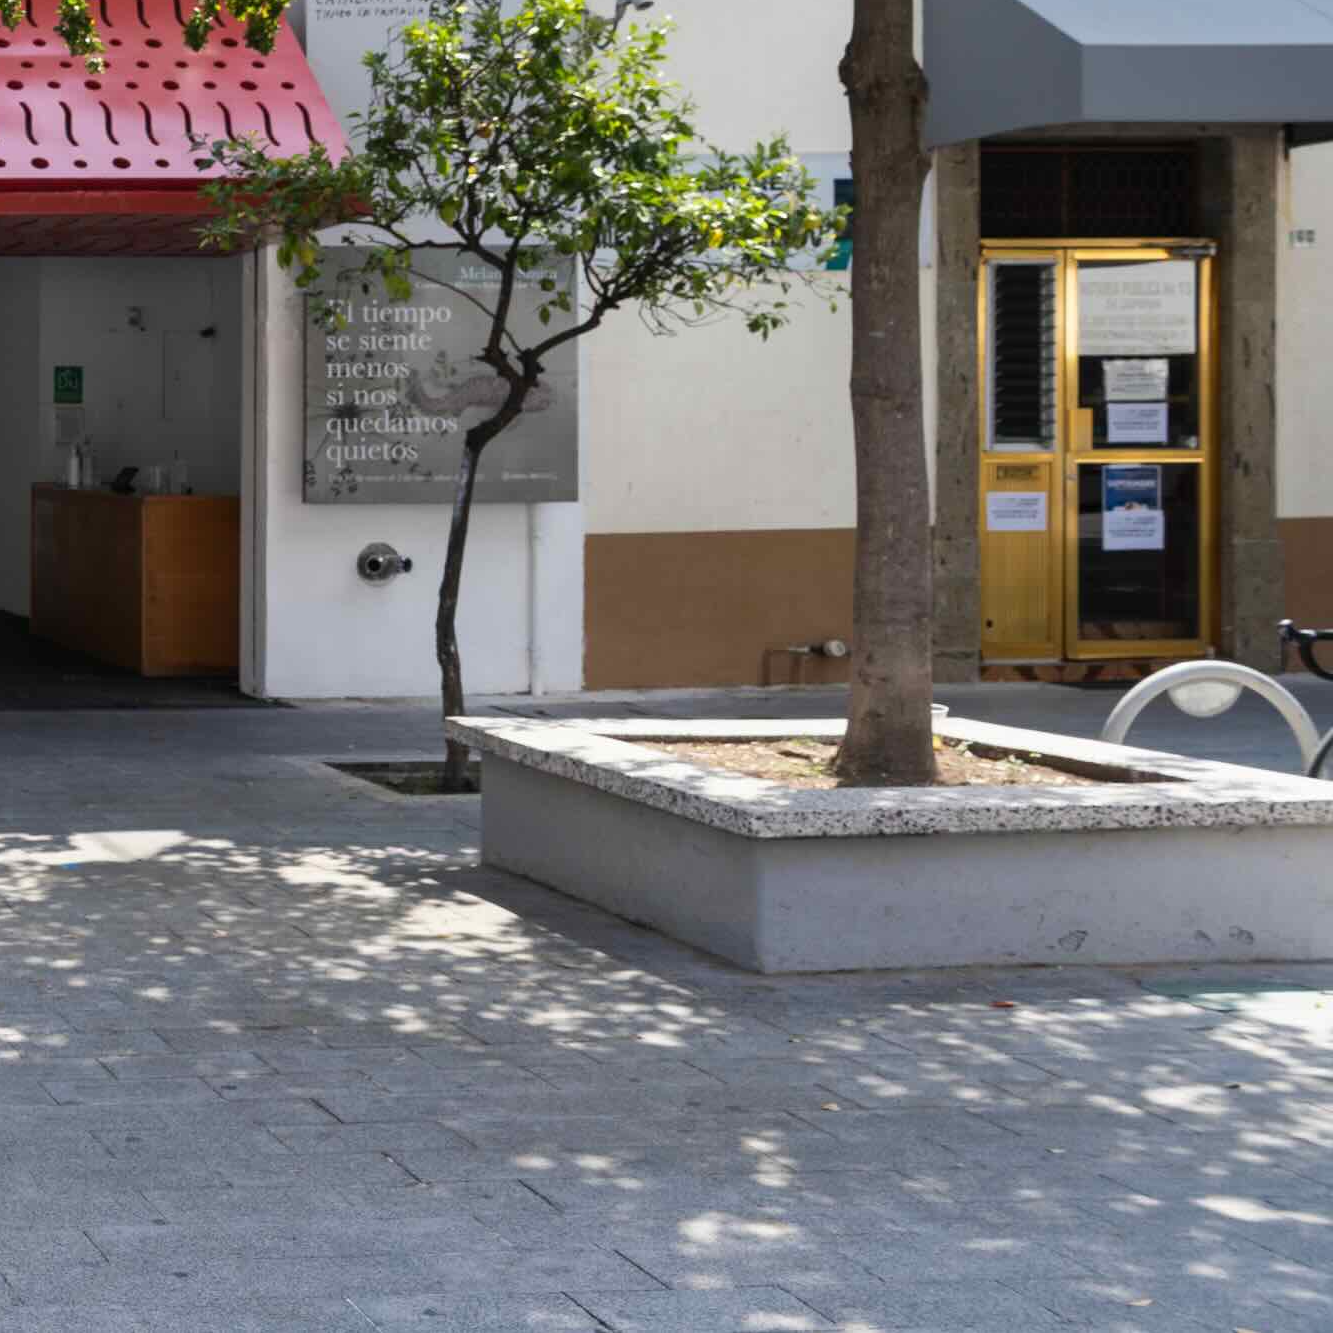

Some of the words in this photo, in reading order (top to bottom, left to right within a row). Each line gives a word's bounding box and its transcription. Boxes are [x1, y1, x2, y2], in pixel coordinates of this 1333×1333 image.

[362, 299, 453, 331] tiempo
[325, 334, 351, 352] se
[358, 326, 433, 352] siente
[326, 361, 411, 379] menos
[325, 382, 346, 406] si
[353, 388, 399, 406] nos
[325, 409, 458, 442] quedamos
[325, 436, 419, 468] quietos
